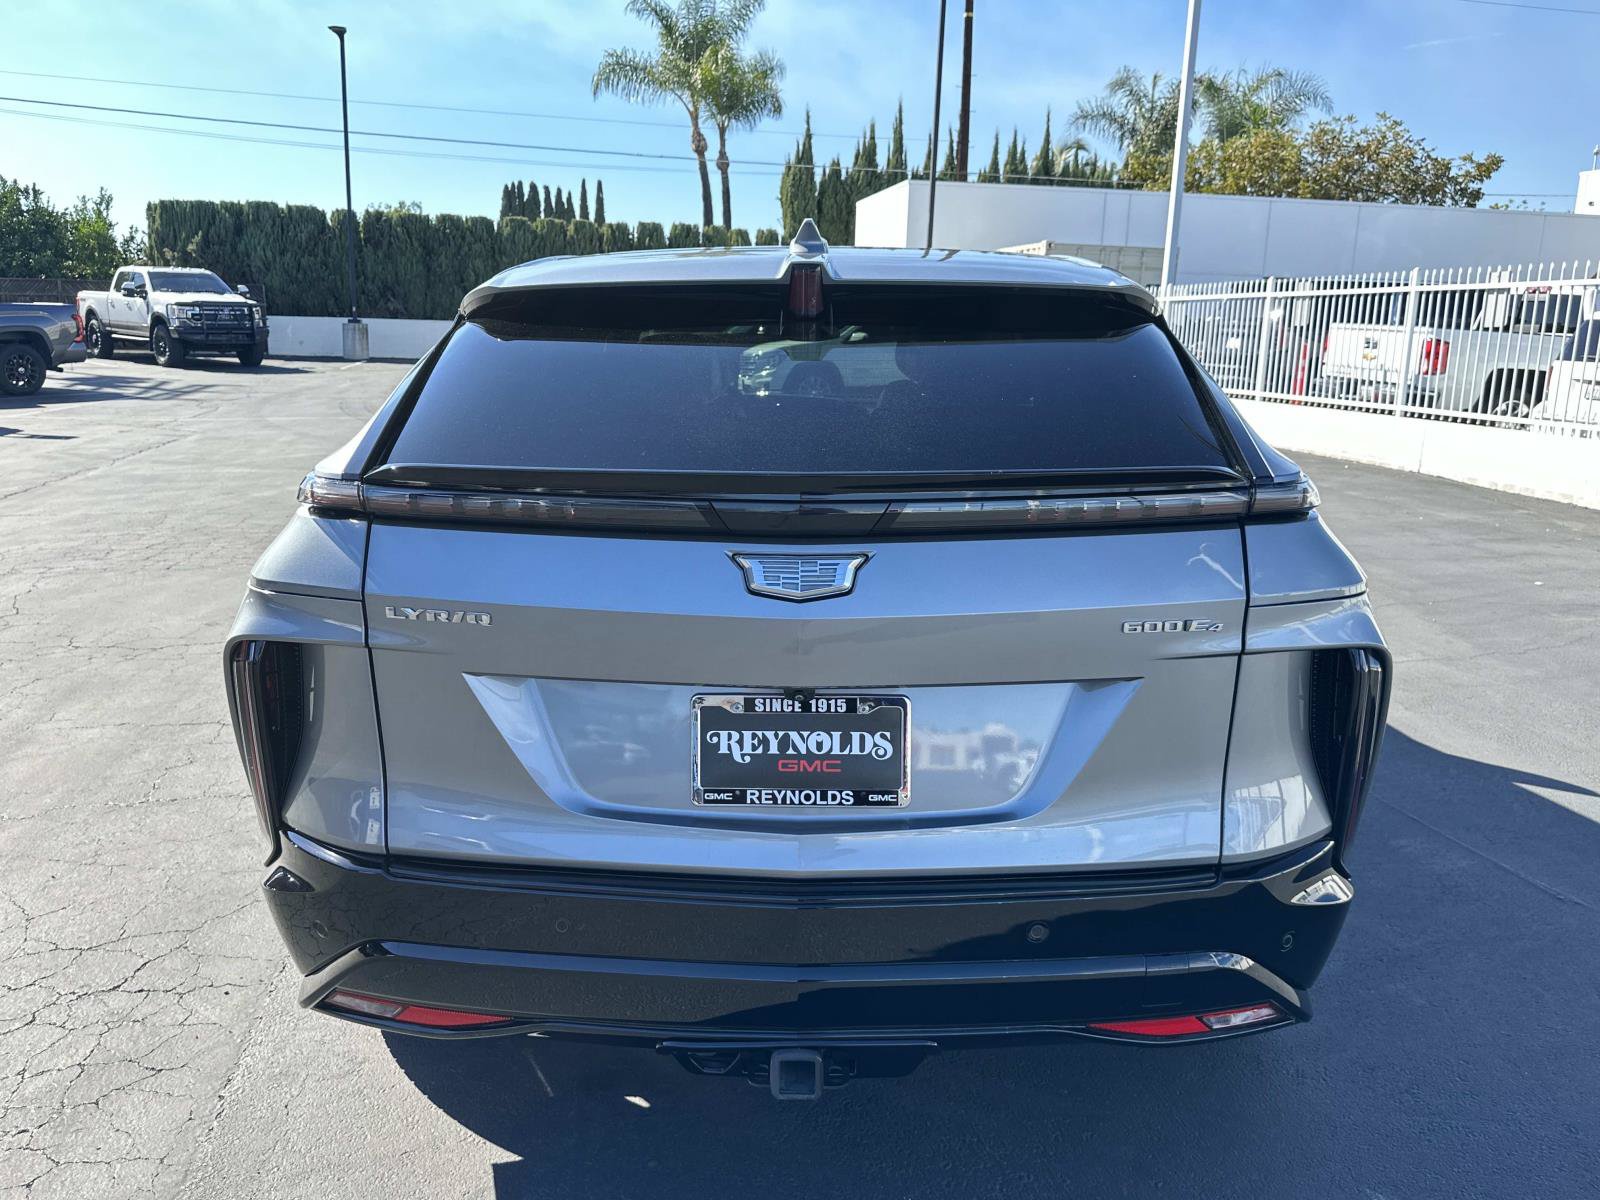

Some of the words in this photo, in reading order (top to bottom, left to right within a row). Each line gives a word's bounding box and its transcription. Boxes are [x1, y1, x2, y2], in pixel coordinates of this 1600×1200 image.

[755, 698, 802, 713] SINCE
[809, 698, 847, 713] 1915
[706, 730, 893, 763] REYNOLDS
[777, 760, 842, 772] GMC
[704, 792, 733, 800] GMC
[746, 789, 854, 805] REYNOLDS
[868, 794, 897, 802] GMC
